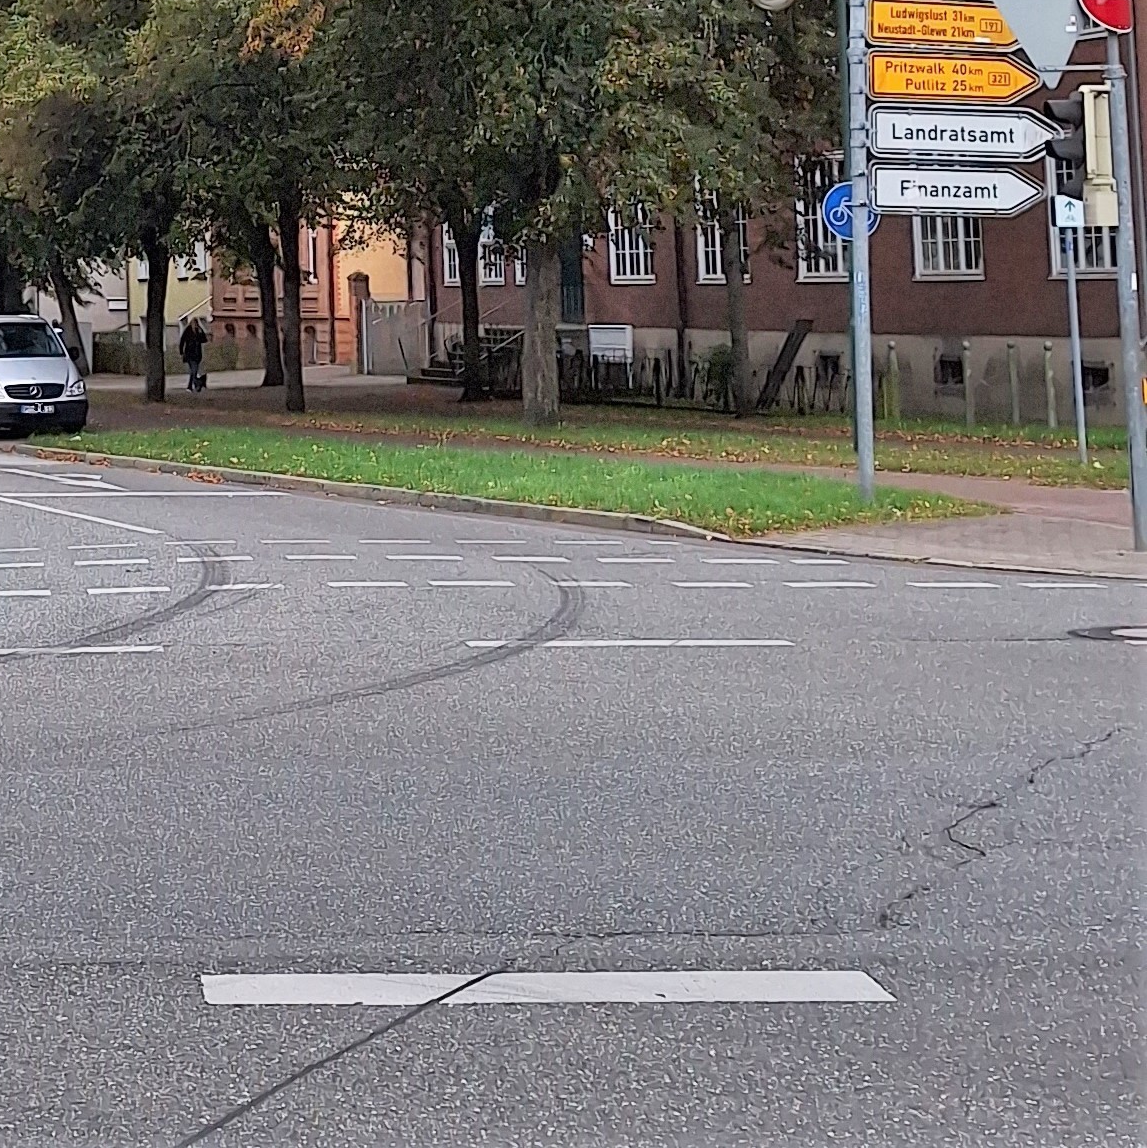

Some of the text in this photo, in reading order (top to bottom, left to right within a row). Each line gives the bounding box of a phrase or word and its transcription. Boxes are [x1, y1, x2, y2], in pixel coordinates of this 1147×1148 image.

[890, 7, 947, 22] Ludwigslust
[877, 23, 948, 37] Neustadt-Glewe
[885, 61, 945, 75] Pritzwalk
[905, 78, 946, 91] Putlitz
[991, 74, 1007, 84] 321
[892, 123, 1014, 143] Landratsamt
